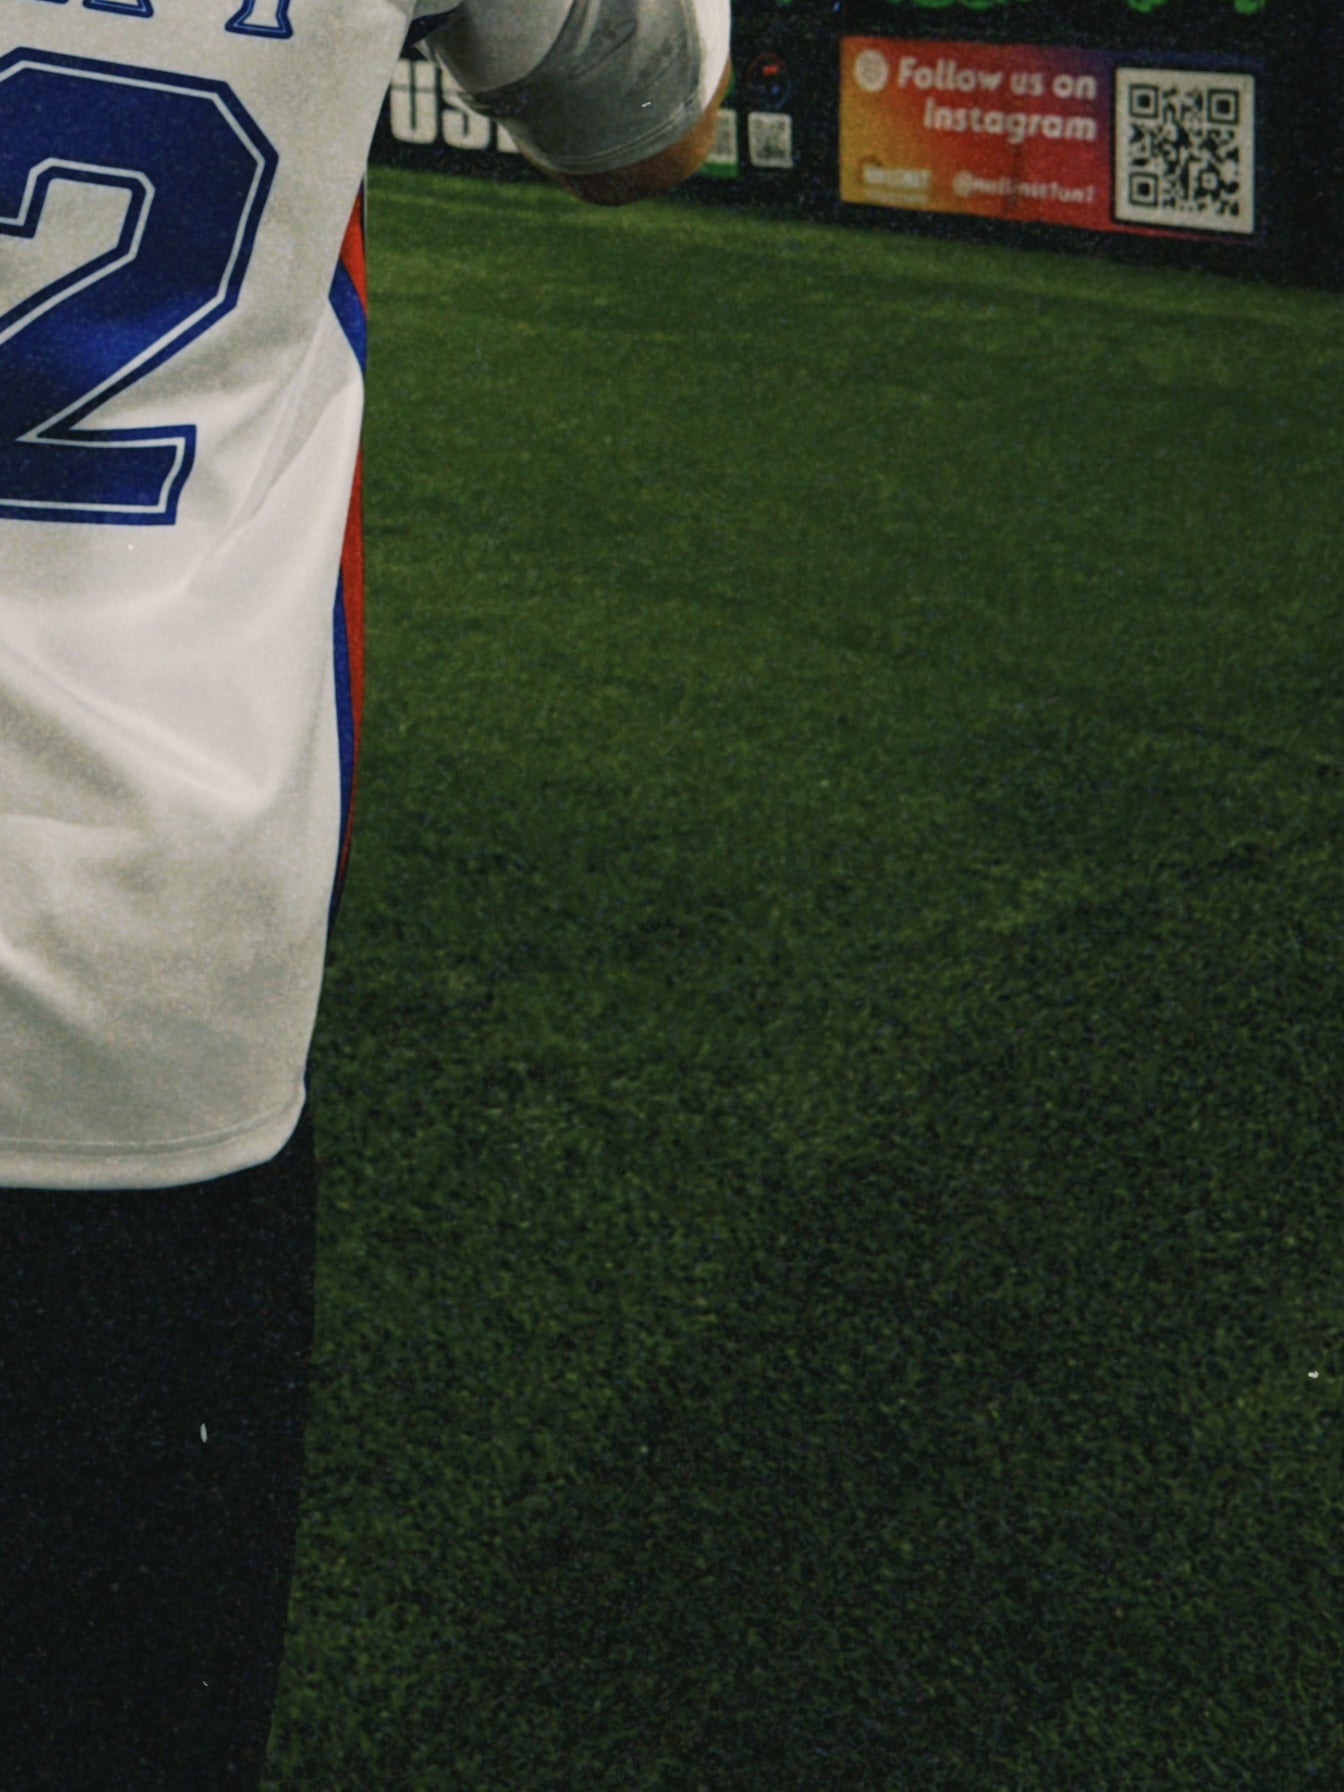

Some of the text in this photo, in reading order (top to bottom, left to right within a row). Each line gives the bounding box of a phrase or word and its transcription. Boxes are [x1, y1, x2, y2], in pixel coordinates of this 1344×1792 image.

[897, 55, 1098, 101] Follow us on
[923, 97, 1098, 145] Instagram
